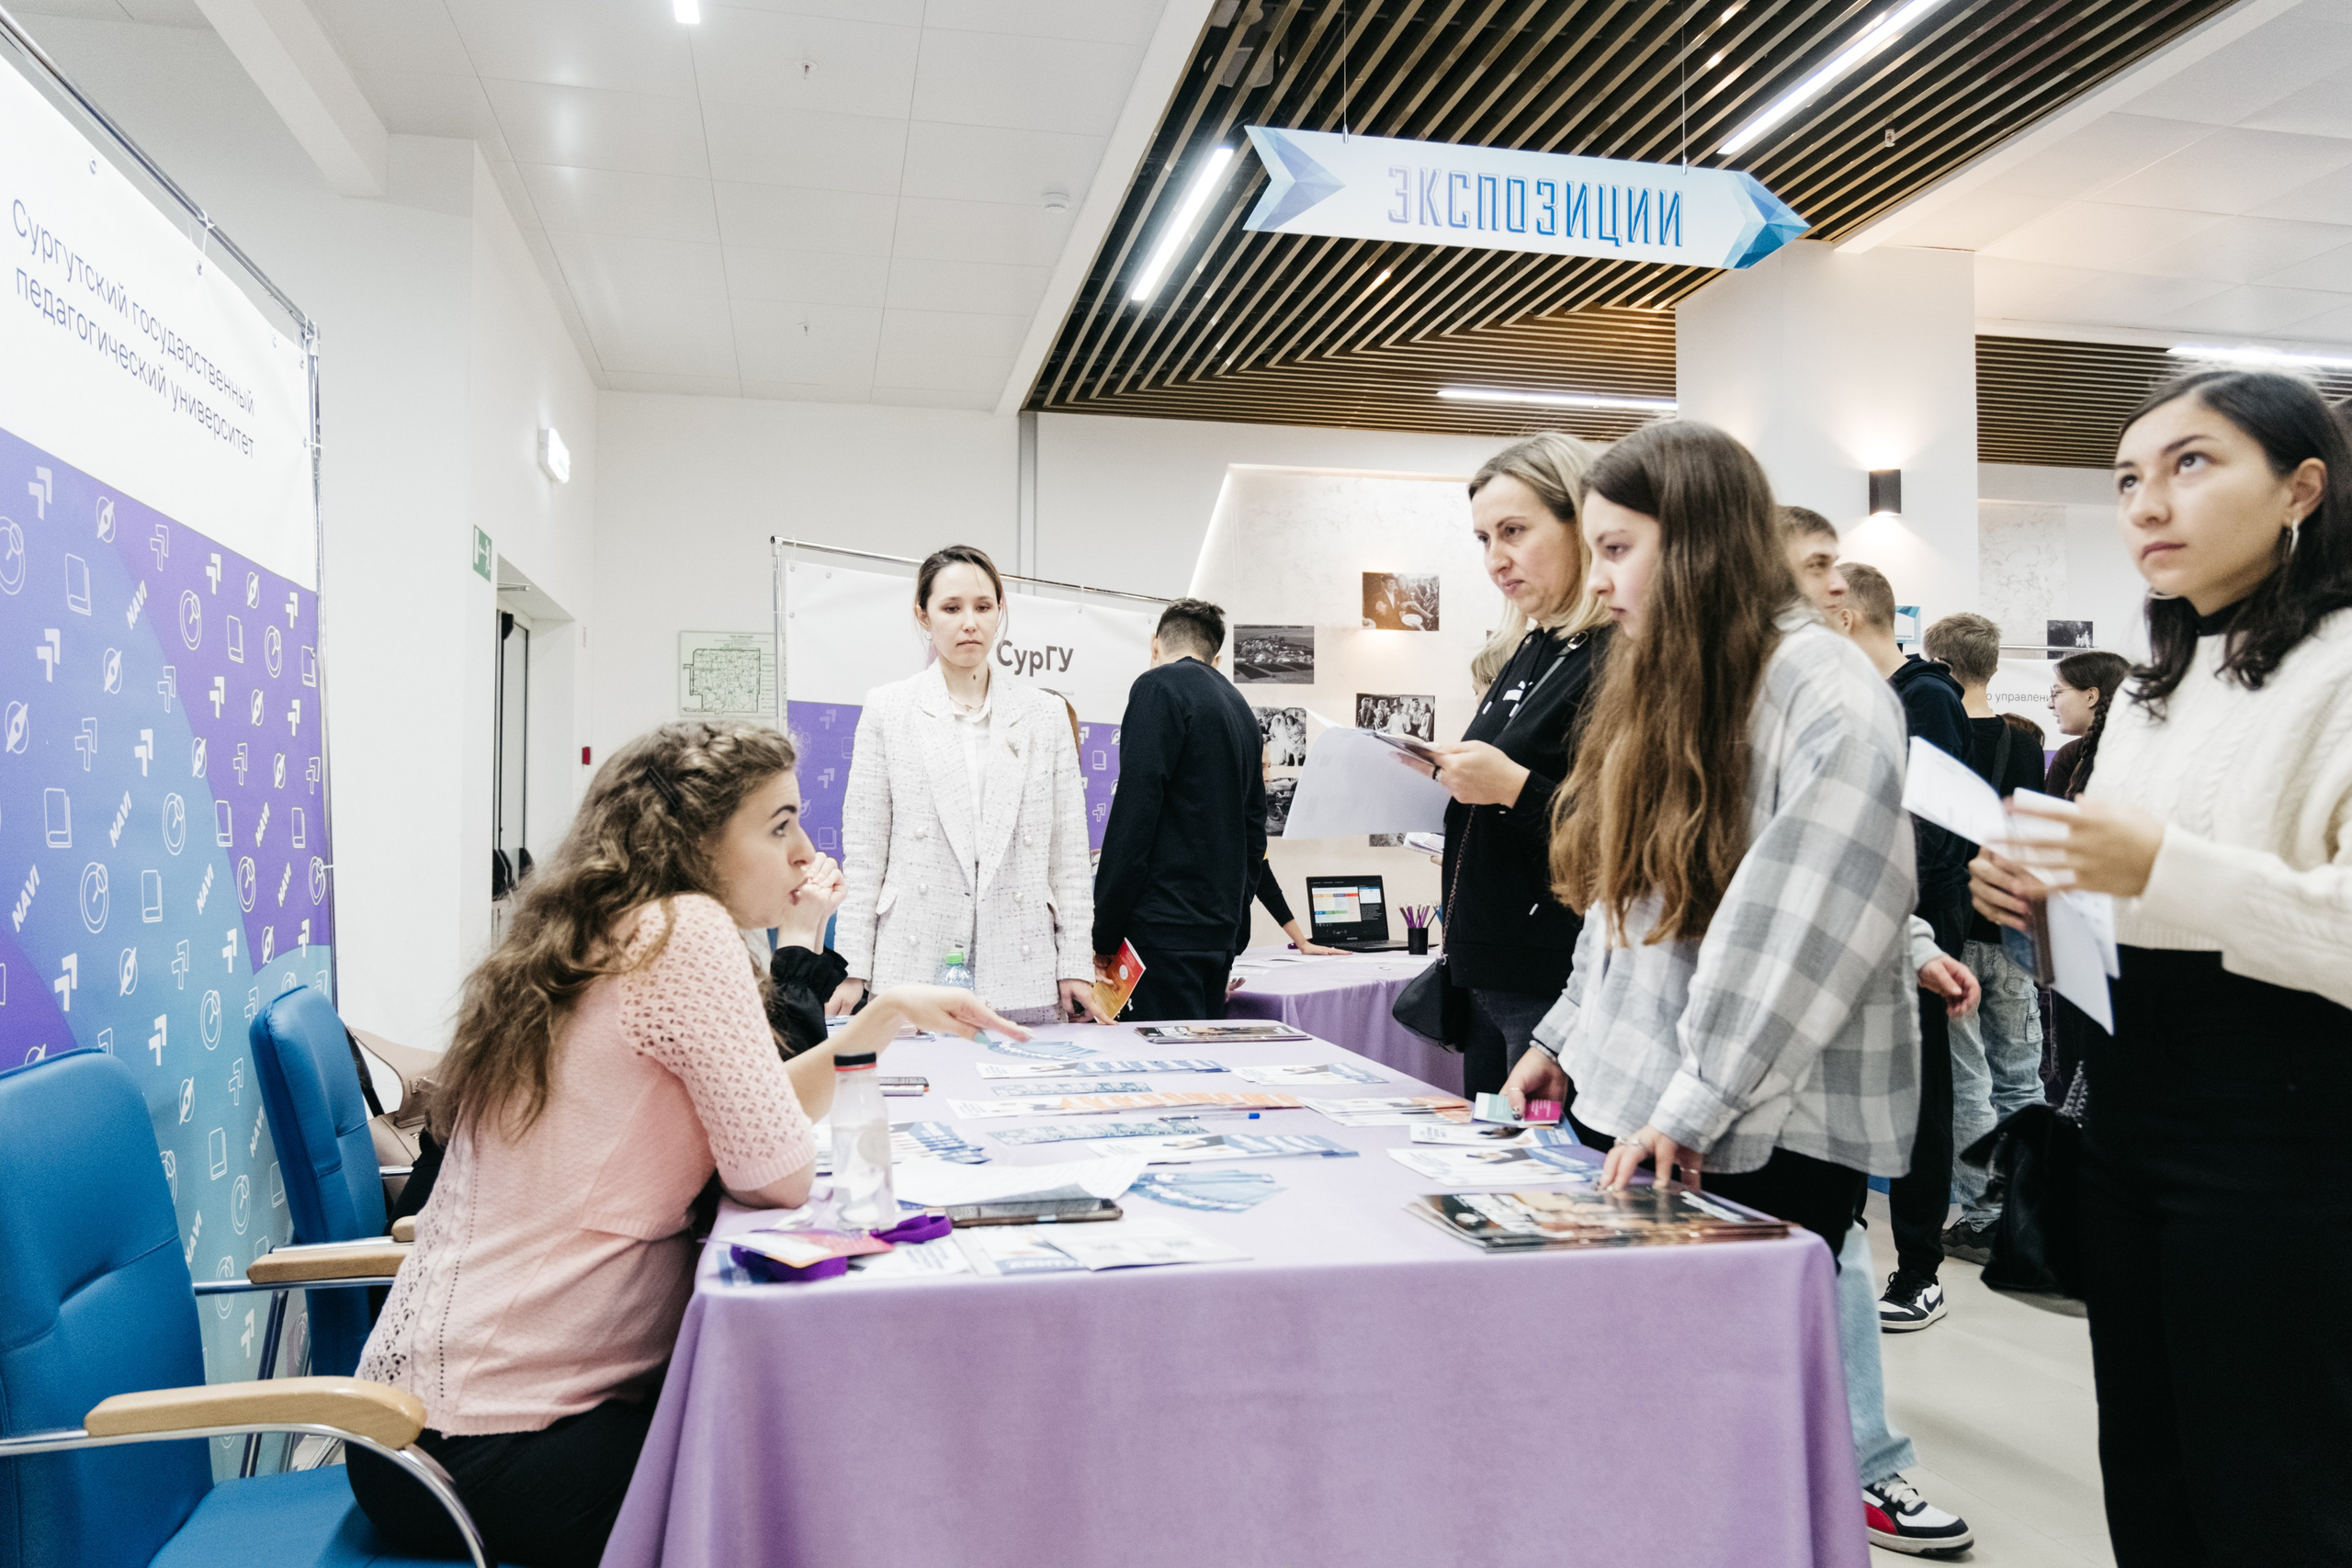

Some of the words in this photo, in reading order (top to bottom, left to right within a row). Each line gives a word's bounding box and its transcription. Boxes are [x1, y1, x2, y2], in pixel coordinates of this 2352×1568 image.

[1388, 165, 1682, 246] ЭКСПОЗИЦИИ
[13, 198, 128, 318] Сургутский
[132, 300, 254, 417] государственный
[17, 267, 166, 398] педагогический
[171, 380, 254, 458] университет
[126, 580, 147, 630] NAVI
[996, 639, 1074, 677] СурГУ
[1996, 693, 2052, 704] управлени
[109, 791, 132, 848] NAVI
[255, 802, 270, 847] NAVI
[12, 864, 40, 932] NAVI
[197, 863, 214, 915] NAVI
[277, 862, 292, 908] NAVI
[250, 1106, 265, 1157] NAVI
